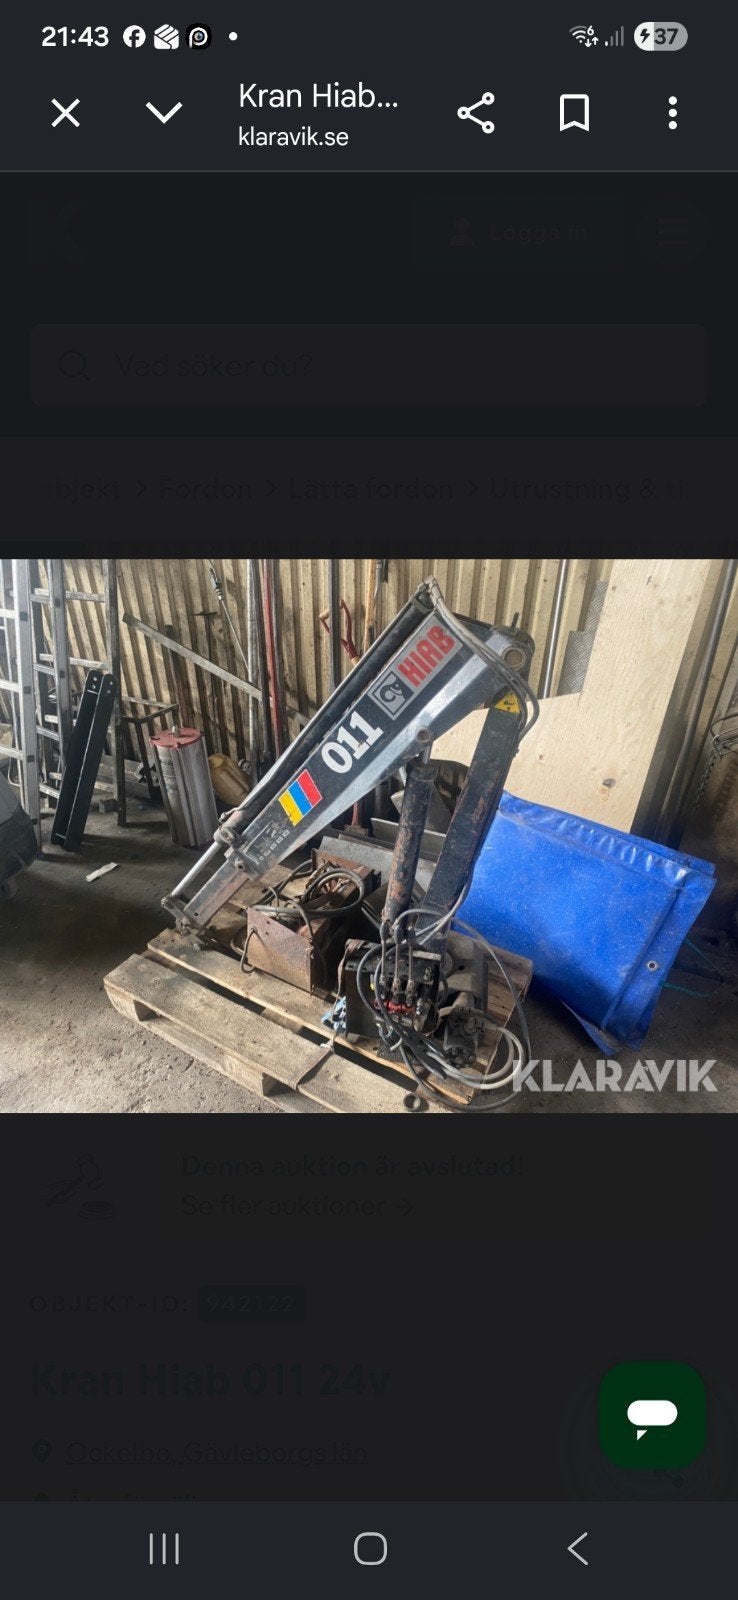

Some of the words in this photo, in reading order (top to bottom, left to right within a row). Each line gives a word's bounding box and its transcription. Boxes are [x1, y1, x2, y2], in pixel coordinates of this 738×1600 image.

[41, 26, 109, 47] 21:43
[586, 25, 595, 36] 6
[654, 28, 679, 45] 37
[239, 83, 302, 108] Kran
[313, 82, 399, 108] Hiab...
[238, 125, 349, 147] klaravik.se
[489, 222, 560, 249] Logga
[569, 222, 588, 241] in
[116, 353, 168, 378] Vad
[177, 353, 255, 378] söker
[262, 353, 313, 378] du?
[160, 477, 253, 500] Fordon
[290, 477, 359, 500] Lätta
[365, 476, 454, 500] fordon
[490, 477, 630, 504] Utrustning
[640, 478, 657, 500] &
[396, 625, 456, 687] HIAB
[321, 711, 384, 774] 011
[182, 1155, 265, 1177] Denna
[272, 1153, 369, 1177] auktion
[376, 1154, 401, 1177] är
[408, 1153, 525, 1177] avslutad!
[181, 1194, 214, 1218] Se
[220, 1193, 261, 1218] fler
[267, 1193, 387, 1218] auktioner
[29, 1295, 190, 1313] OBJEKT-ID:
[207, 1295, 297, 1313] 942122
[31, 1362, 125, 1396] Kran
[139, 1362, 231, 1396] Hiab
[242, 1362, 304, 1396] 011
[319, 1362, 392, 1396] 24v
[65, 1441, 178, 1465] Ockelbo,
[184, 1440, 327, 1467] Gävleborgs
[333, 1440, 369, 1464] län
